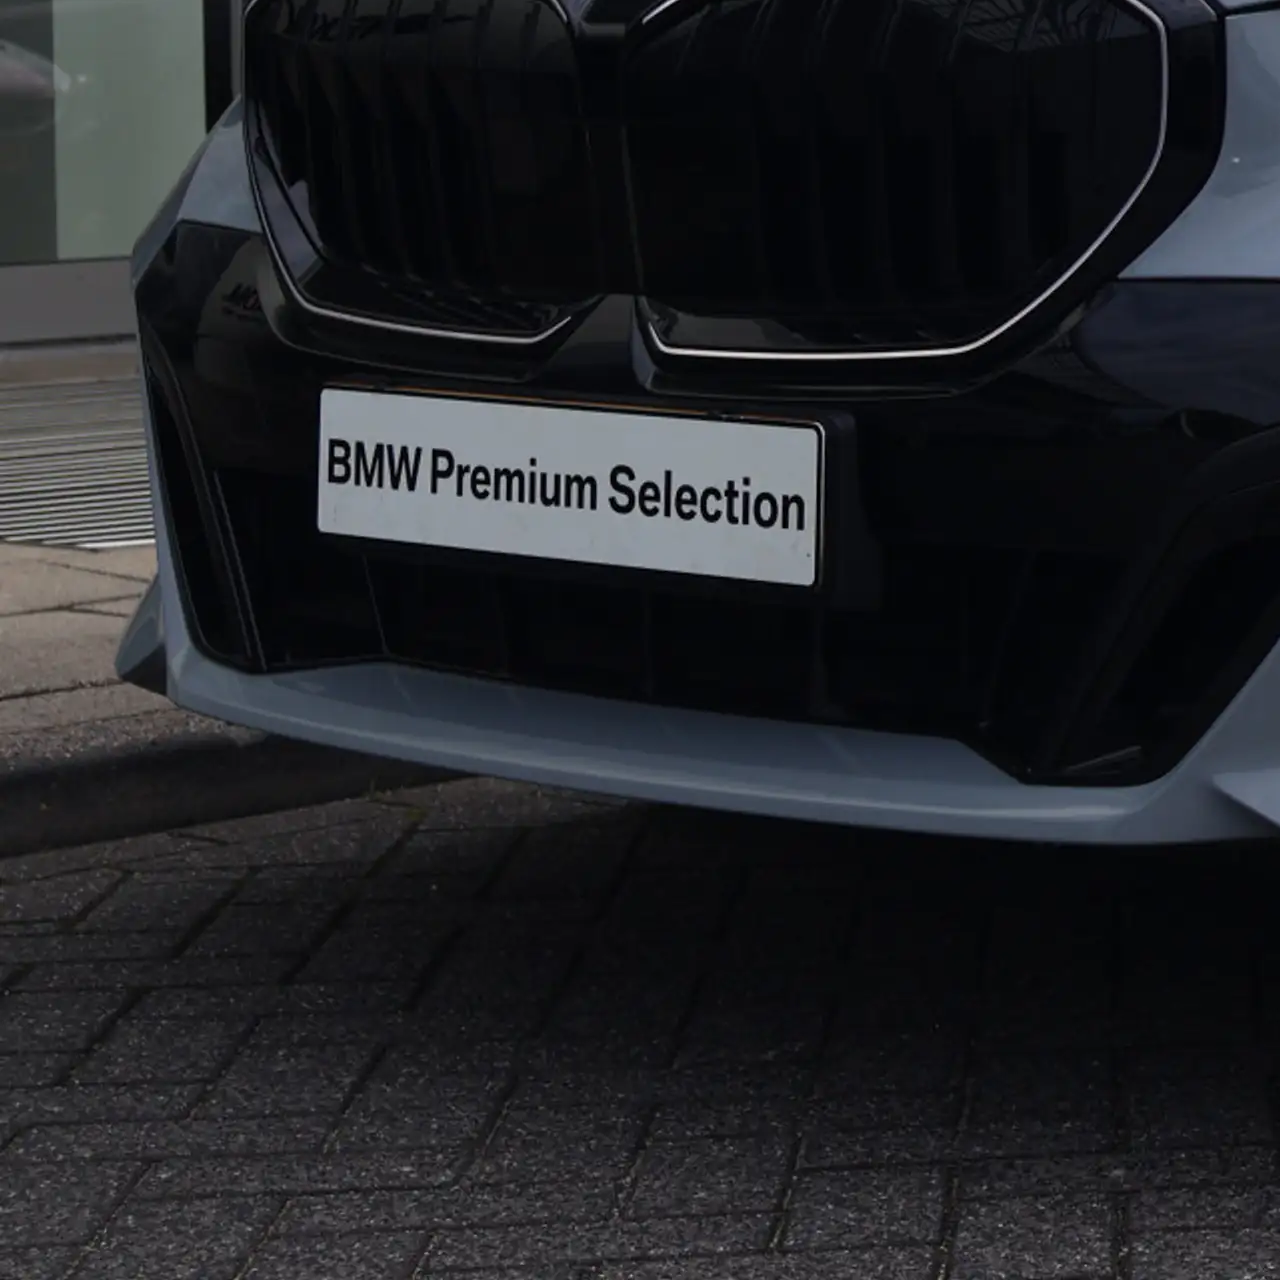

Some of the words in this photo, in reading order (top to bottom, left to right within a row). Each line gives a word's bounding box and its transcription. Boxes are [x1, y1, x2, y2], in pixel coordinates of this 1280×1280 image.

[327, 438, 422, 492] BMW
[430, 448, 598, 511] Premium
[608, 464, 806, 531] Selection
